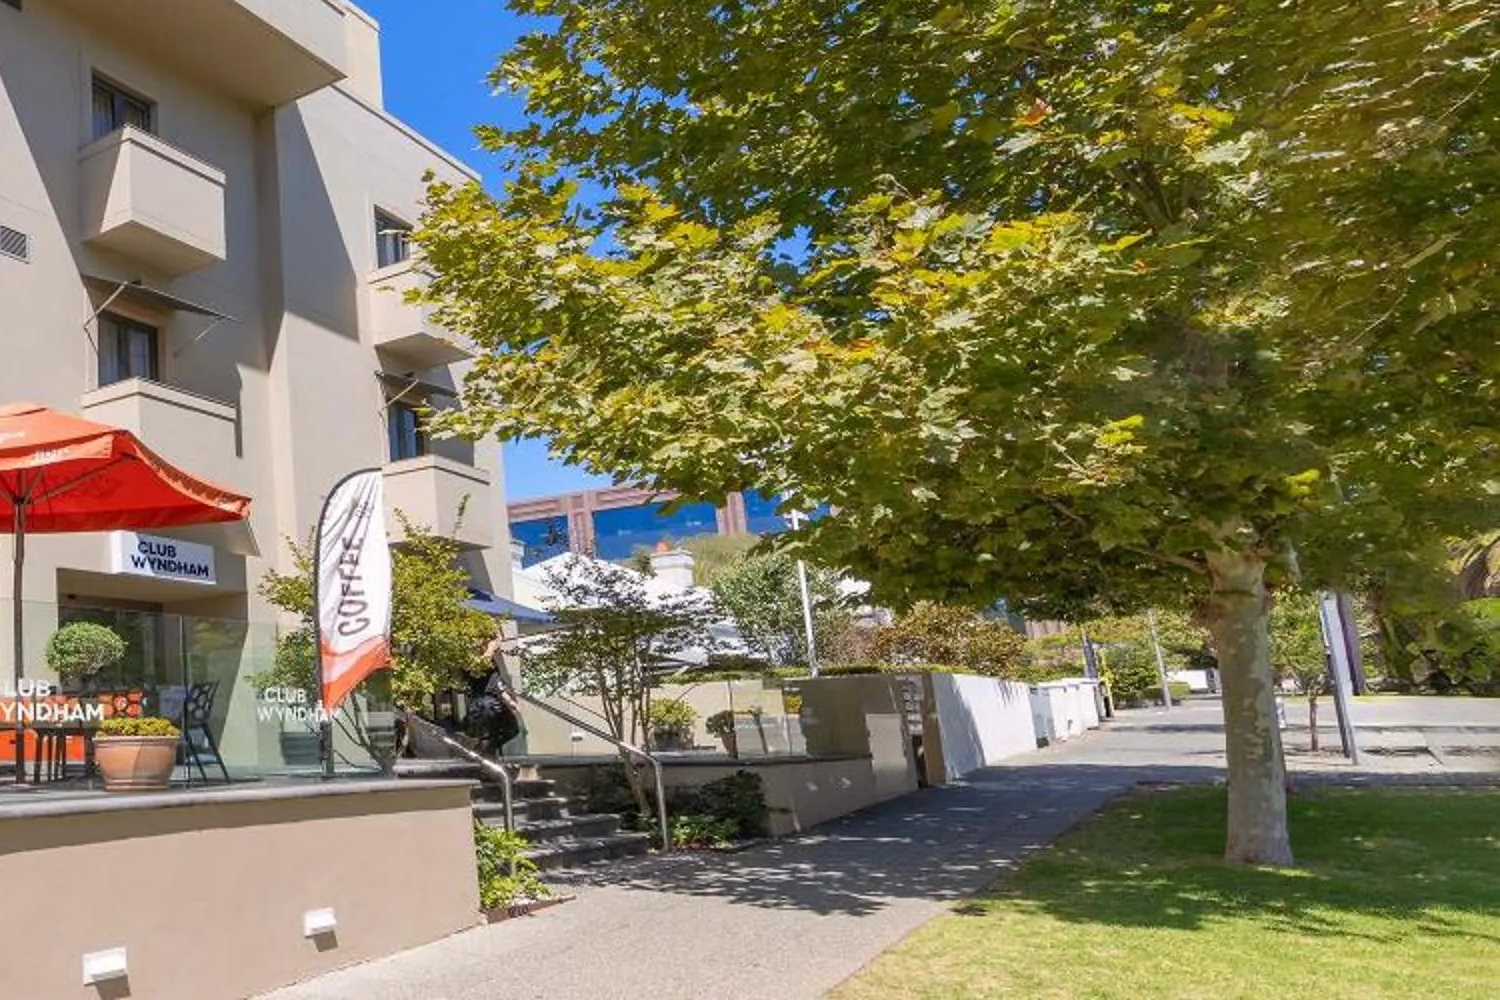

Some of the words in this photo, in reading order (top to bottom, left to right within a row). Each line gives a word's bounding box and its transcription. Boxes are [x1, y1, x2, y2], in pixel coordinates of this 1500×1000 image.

[138, 541, 176, 558] CLUB
[131, 554, 209, 577] WYNDHAM
[337, 537, 371, 636] COFFEE
[264, 687, 307, 703] CLUB
